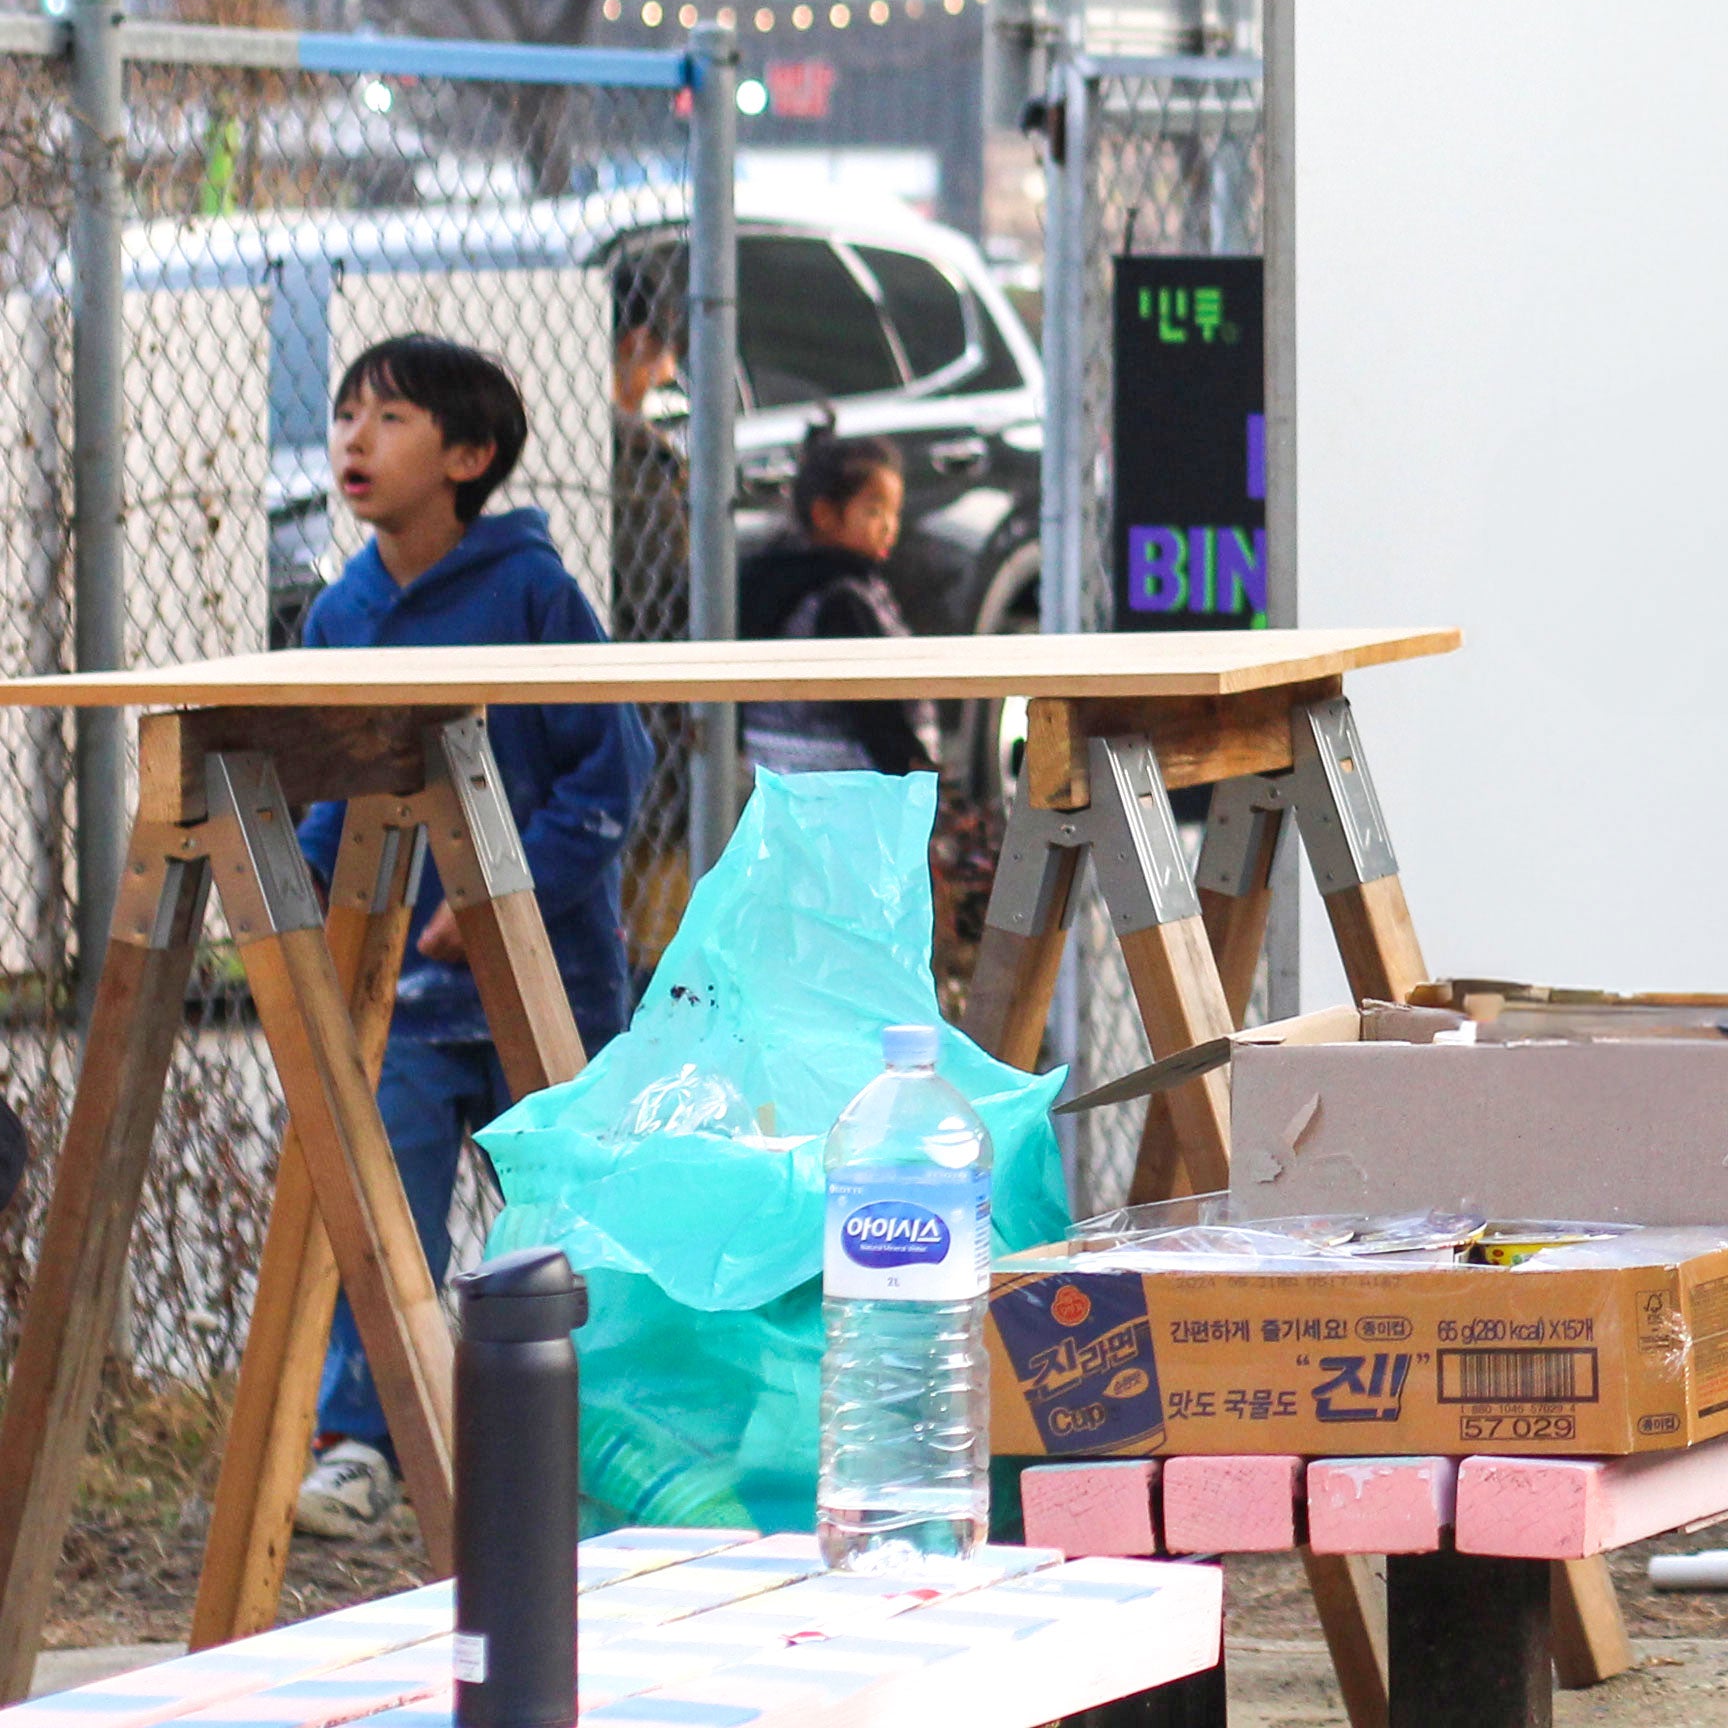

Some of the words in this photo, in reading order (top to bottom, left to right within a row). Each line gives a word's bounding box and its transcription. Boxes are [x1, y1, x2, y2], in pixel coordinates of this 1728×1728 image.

[846, 1216, 942, 1244] 아이시스
[1169, 1319, 1250, 1344] 간편하게
[1261, 1318, 1348, 1343] 즐기세요!
[1028, 1324, 1140, 1401] 진라면
[1047, 1401, 1107, 1437] Cup
[1168, 1390, 1216, 1420] 맛도
[1223, 1389, 1298, 1421] 국물도
[1464, 1418, 1504, 1439] 57
[1512, 1418, 1573, 1438] 029
